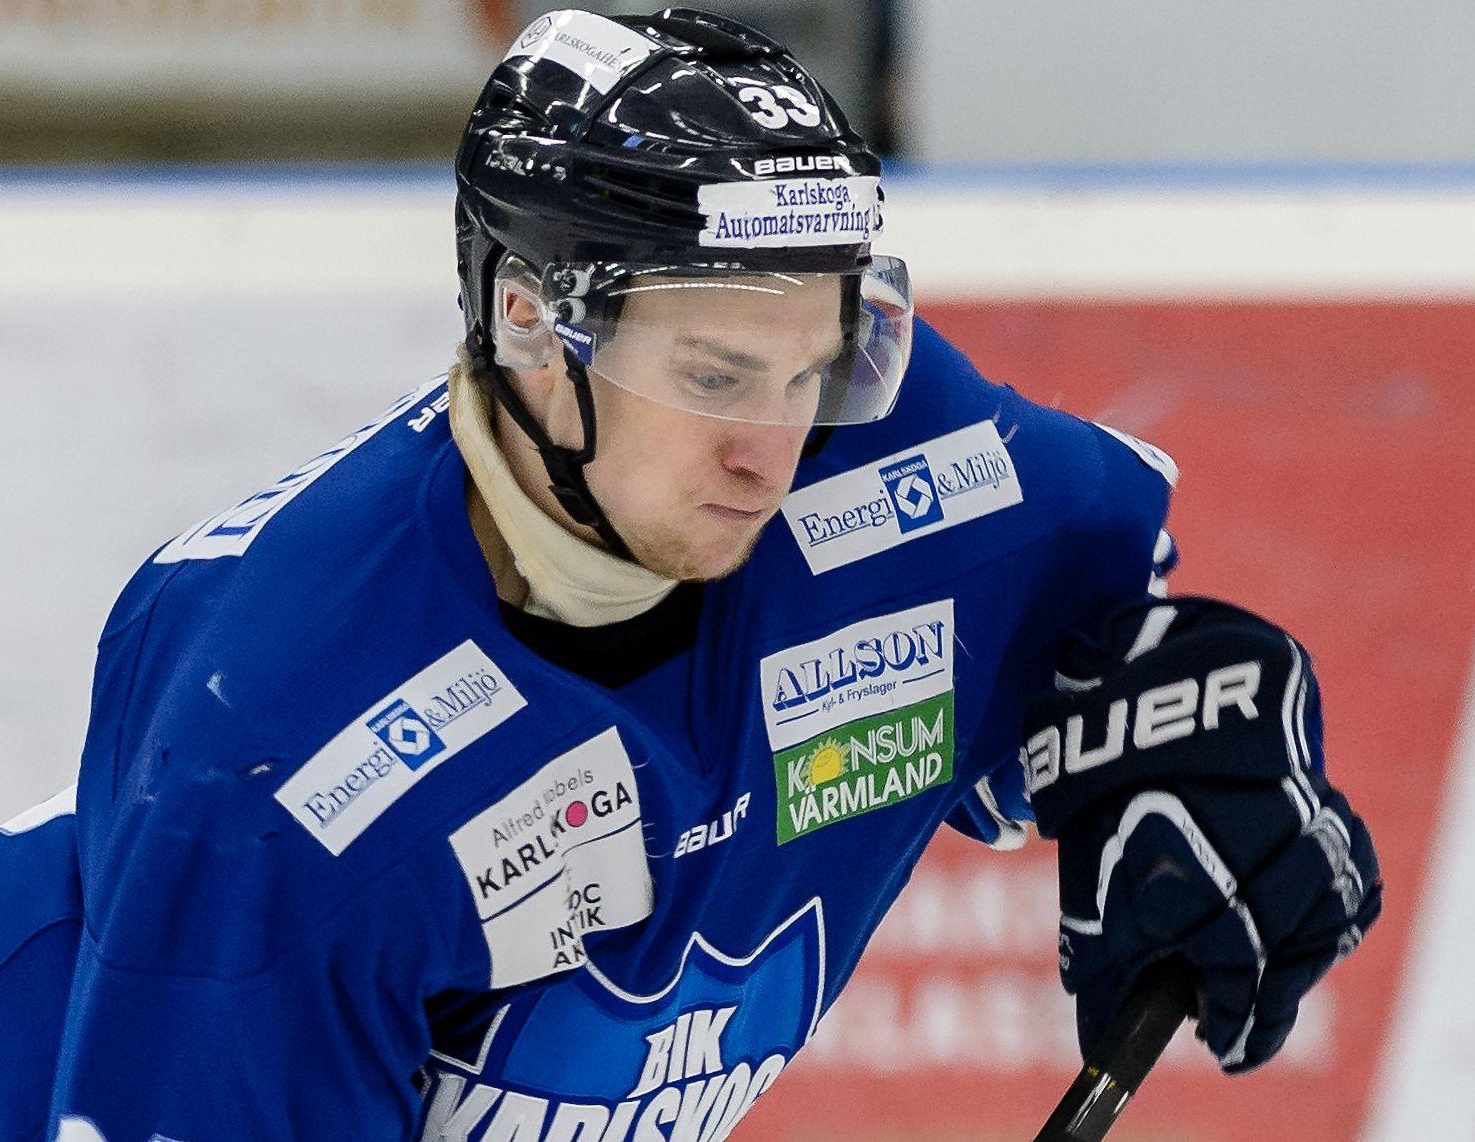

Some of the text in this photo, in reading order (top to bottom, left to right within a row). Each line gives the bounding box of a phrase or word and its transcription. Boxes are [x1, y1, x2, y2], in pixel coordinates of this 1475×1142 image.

[739, 85, 821, 129] 33
[753, 155, 852, 176] BAUER
[715, 204, 871, 240] Automatsvarvning
[775, 182, 851, 211] Karlskoga
[798, 488, 895, 546] Energi
[773, 620, 945, 712] ALLSON
[847, 680, 897, 701] Fryslager
[1020, 660, 1263, 800] AUER
[302, 740, 397, 828] Energi
[789, 752, 943, 834] VÄRMLAND
[491, 803, 545, 849] Alfred
[627, 1006, 739, 1100] BIK
